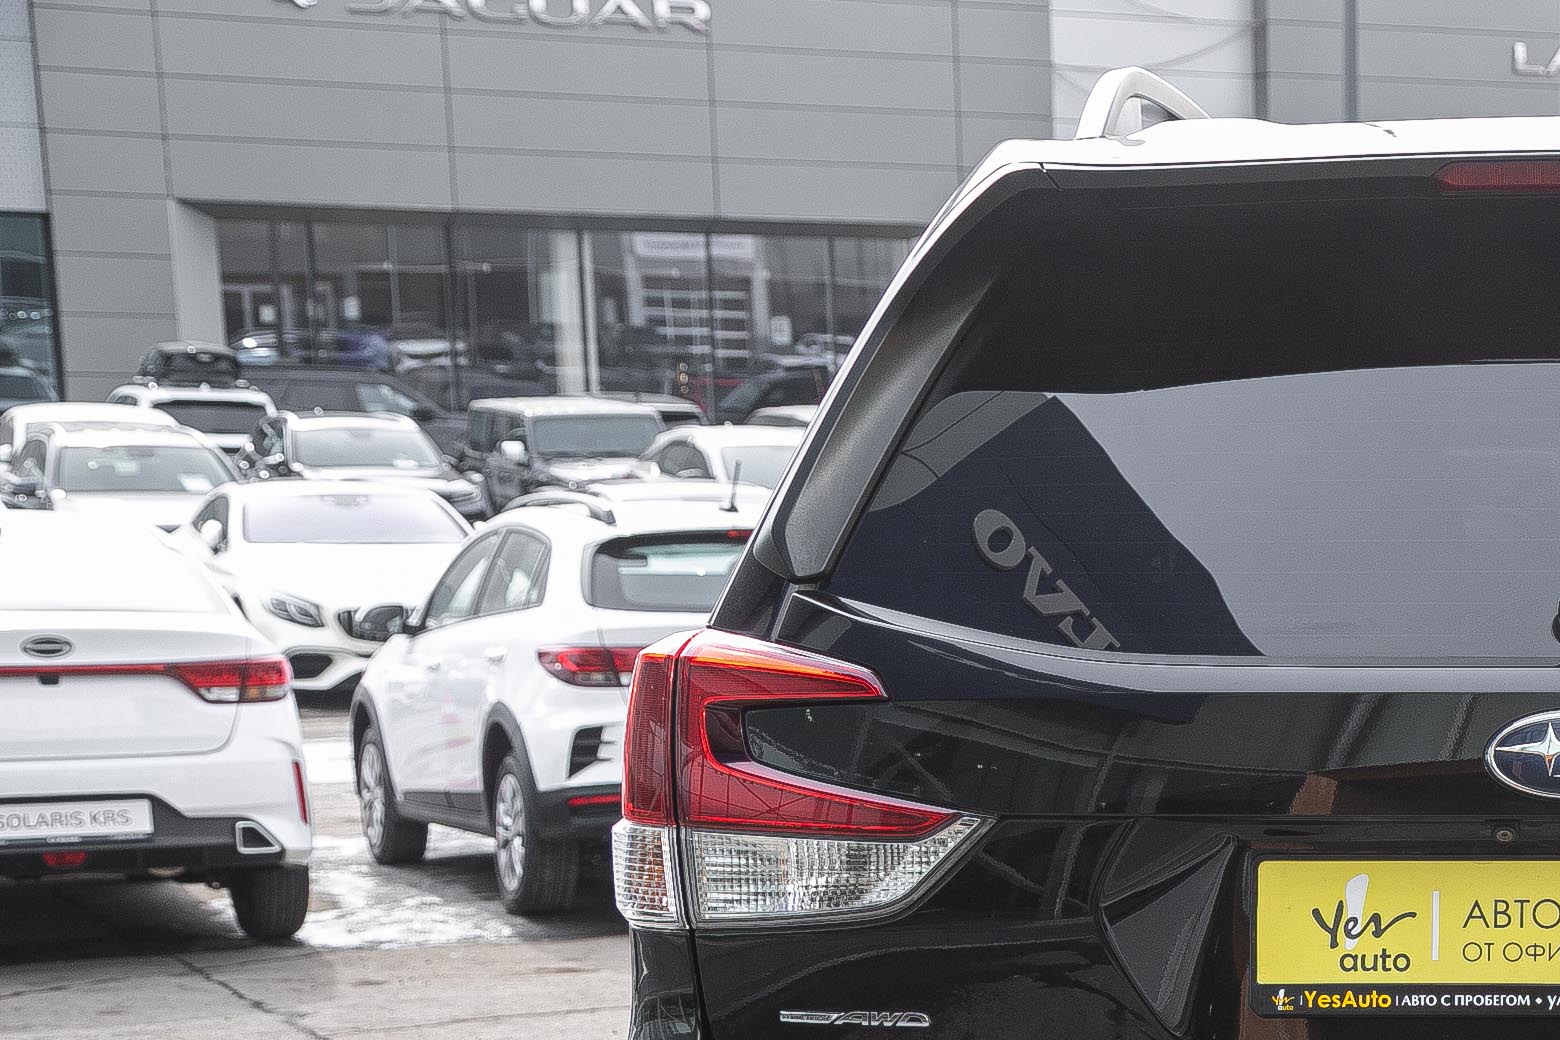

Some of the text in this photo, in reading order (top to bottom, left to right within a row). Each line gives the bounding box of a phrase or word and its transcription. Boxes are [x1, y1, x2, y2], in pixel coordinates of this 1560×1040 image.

[89, 808, 132, 827] KRS
[1311, 896, 1418, 950] Yes
[1338, 947, 1412, 973] auto
[1462, 941, 1495, 963] ОТ
[1303, 989, 1393, 1009] YesAuto
[1401, 994, 1531, 1007] АВТО С ПРОБЕГОМ
[833, 1010, 931, 1027] AWD
